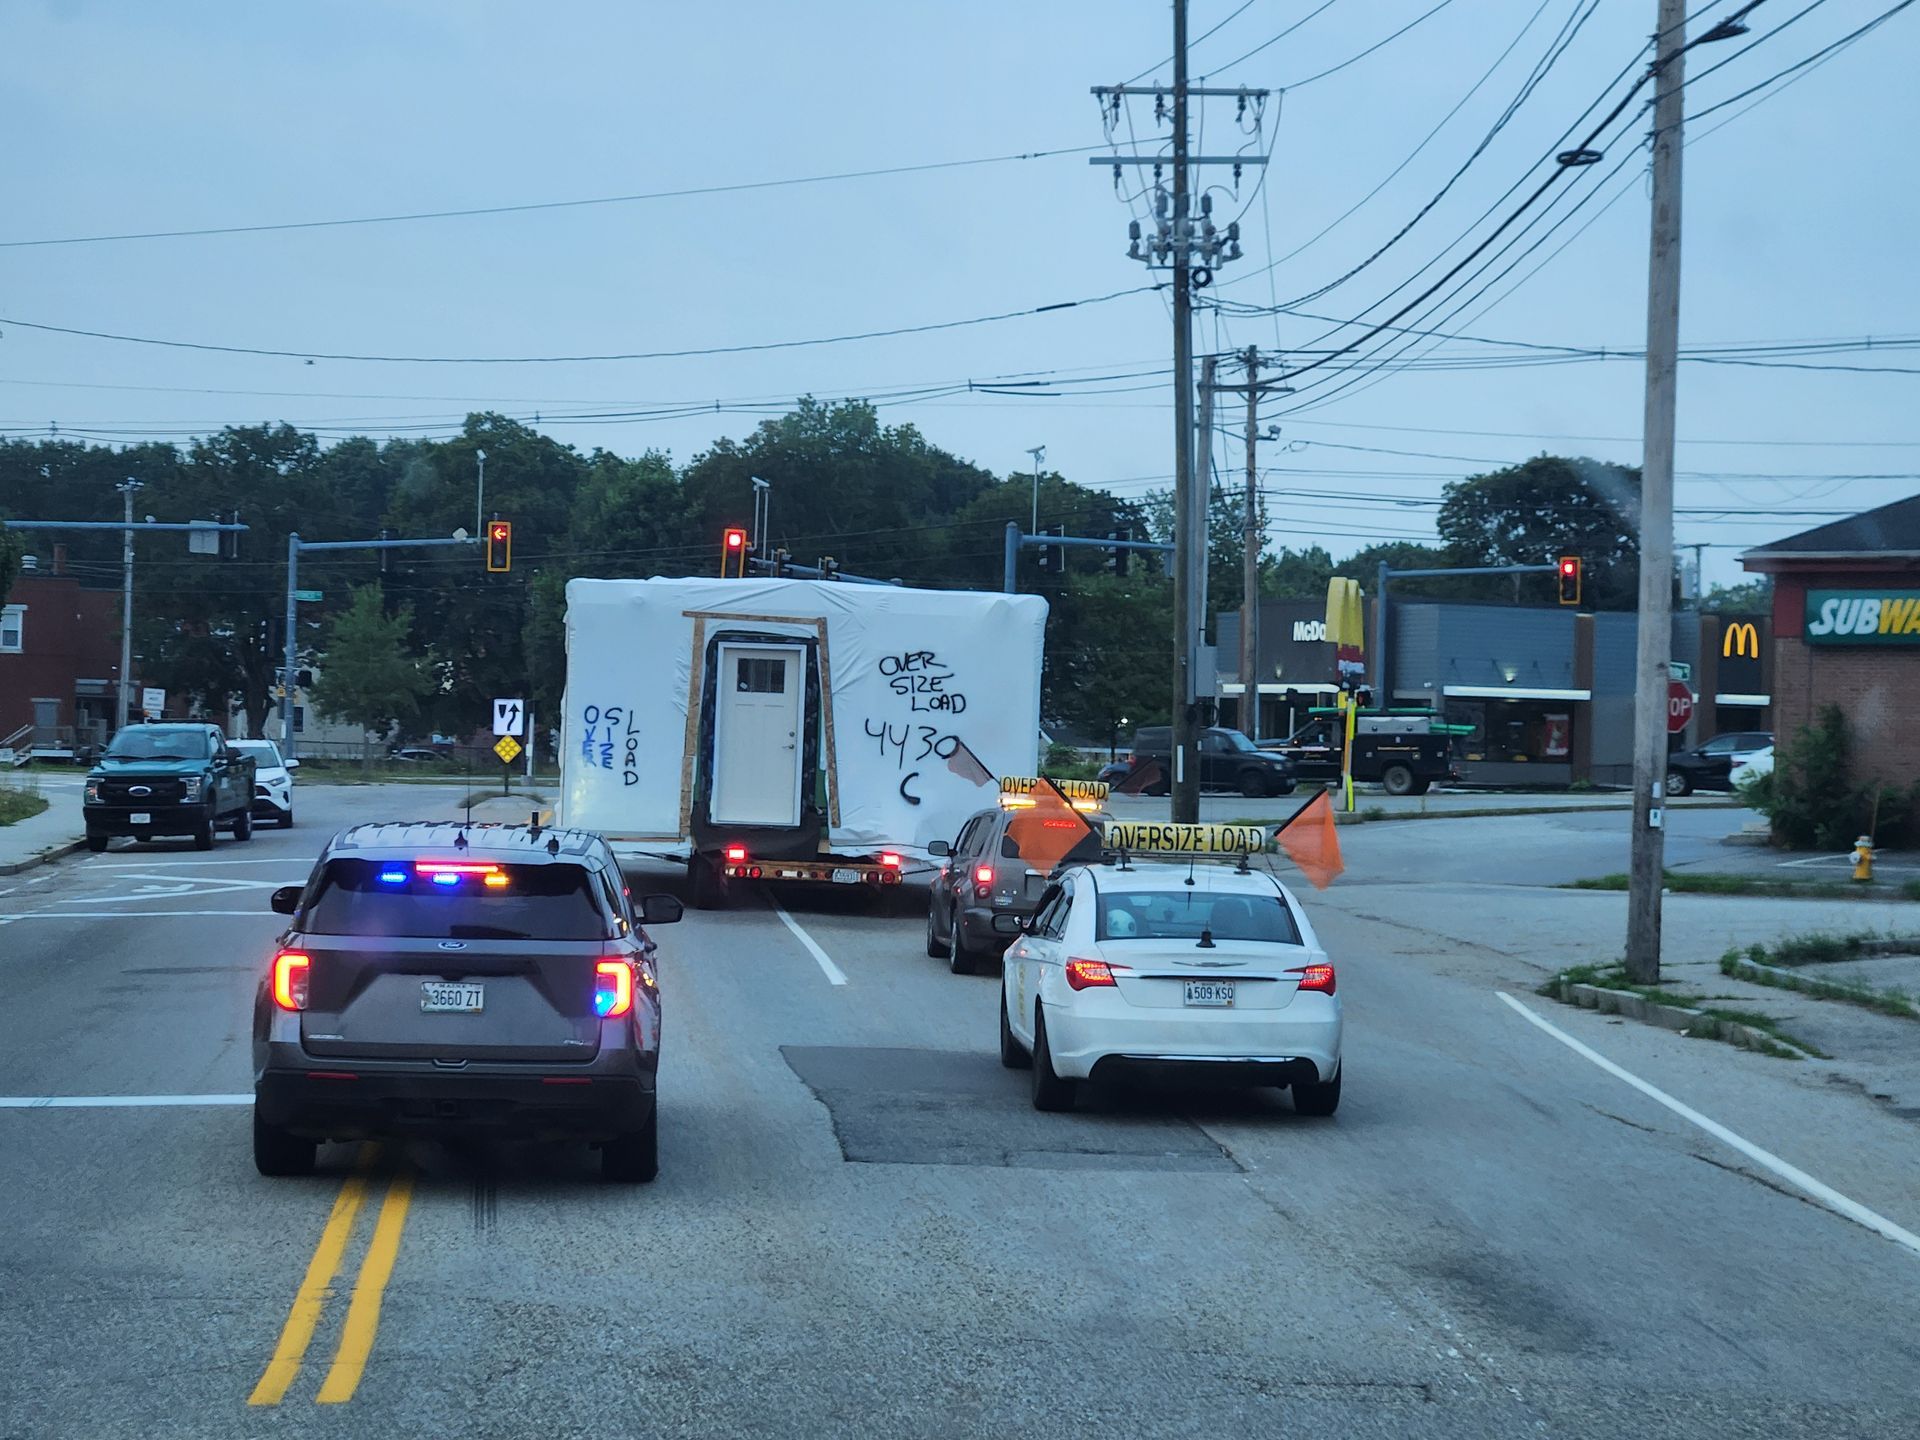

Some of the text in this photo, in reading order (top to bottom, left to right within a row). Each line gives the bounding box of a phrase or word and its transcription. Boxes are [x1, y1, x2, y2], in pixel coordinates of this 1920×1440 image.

[1808, 598, 1920, 636] SUBWA
[1293, 620, 1326, 641] McDo
[879, 651, 948, 676] OVER
[890, 673, 954, 695] SIZE
[911, 693, 967, 714] LOAD
[1669, 697, 1691, 717] OP
[582, 705, 600, 768] OVER
[599, 707, 623, 770] SIZE
[623, 709, 640, 786] LOAD
[865, 718, 960, 769] 4430
[900, 772, 921, 805] C
[1071, 781, 1106, 799] LOAD
[1110, 825, 1262, 853] OVERSIZE LOAD
[432, 989, 481, 1006] 3660 ZT
[1194, 986, 1212, 999] 509
